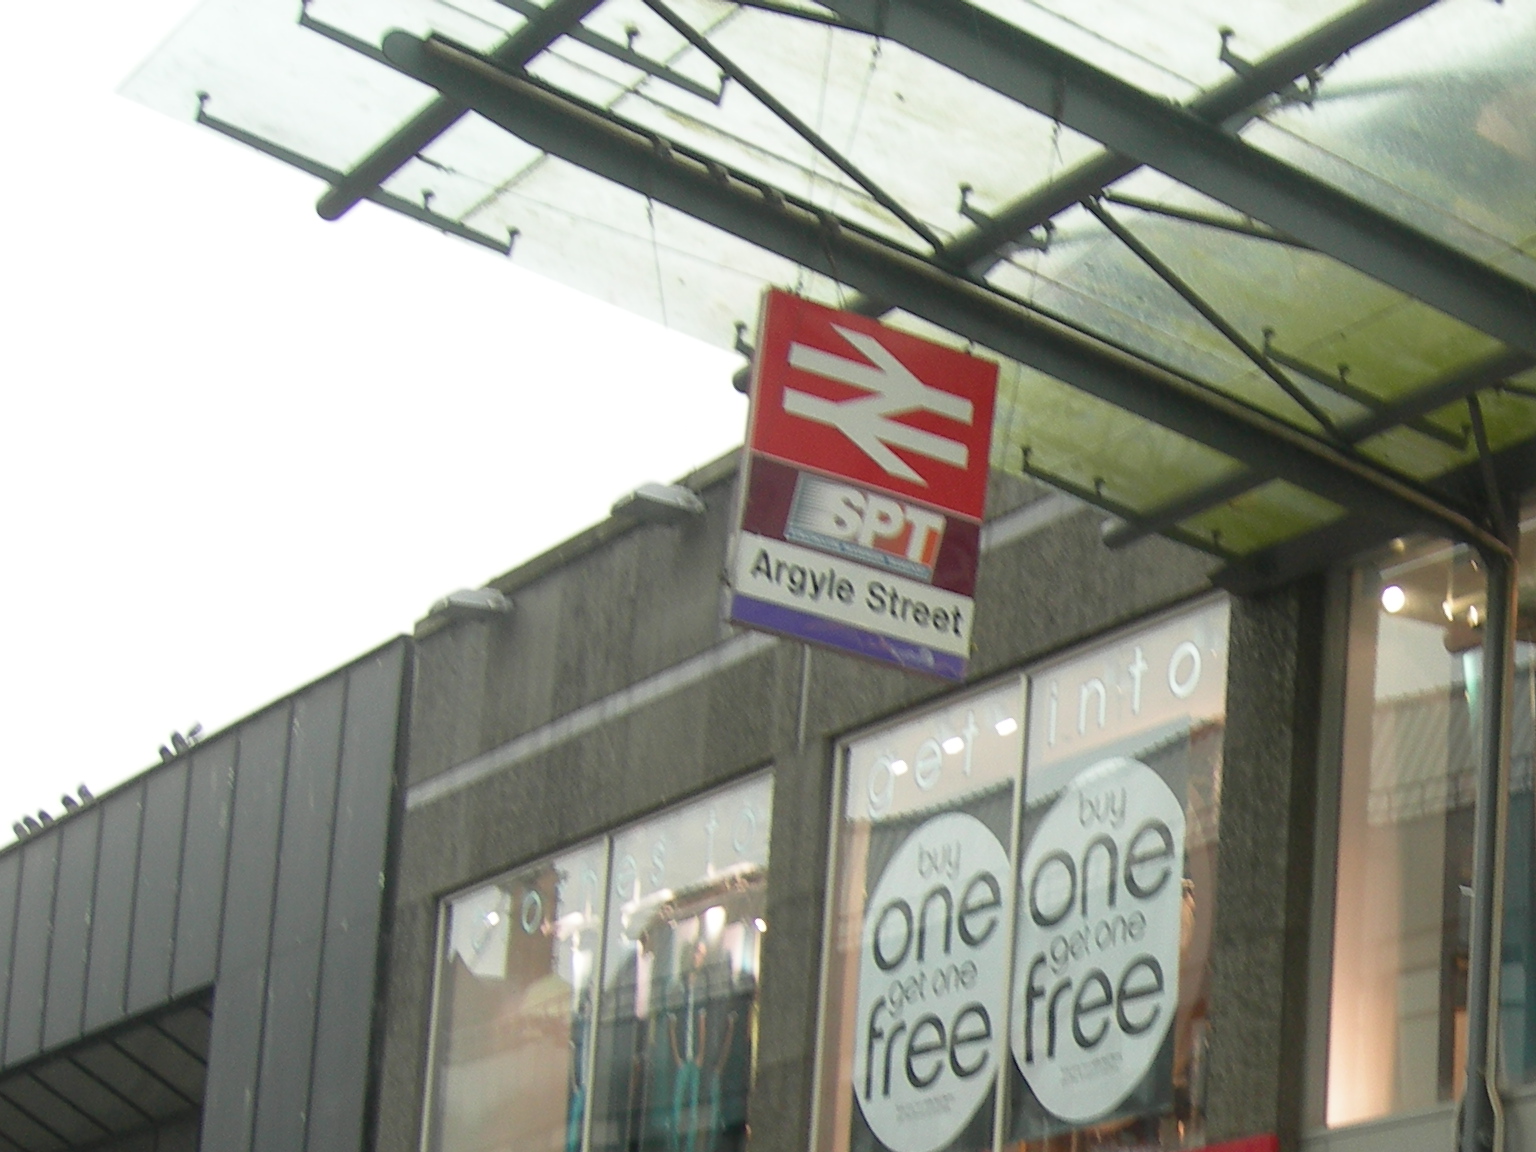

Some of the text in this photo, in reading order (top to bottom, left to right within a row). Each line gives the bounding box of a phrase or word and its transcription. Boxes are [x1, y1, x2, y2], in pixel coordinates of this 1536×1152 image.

[830, 488, 947, 563] SPT
[751, 547, 855, 604] Argyle
[865, 579, 964, 638] Street
[867, 641, 1201, 818] get into
[1077, 787, 1127, 829] buy
[917, 841, 962, 880] buy
[1028, 818, 1175, 926] one
[872, 871, 1003, 971] one
[1049, 909, 1147, 974] get one
[886, 959, 978, 1011] get one
[1025, 951, 1164, 1064] free
[866, 996, 993, 1102] free
